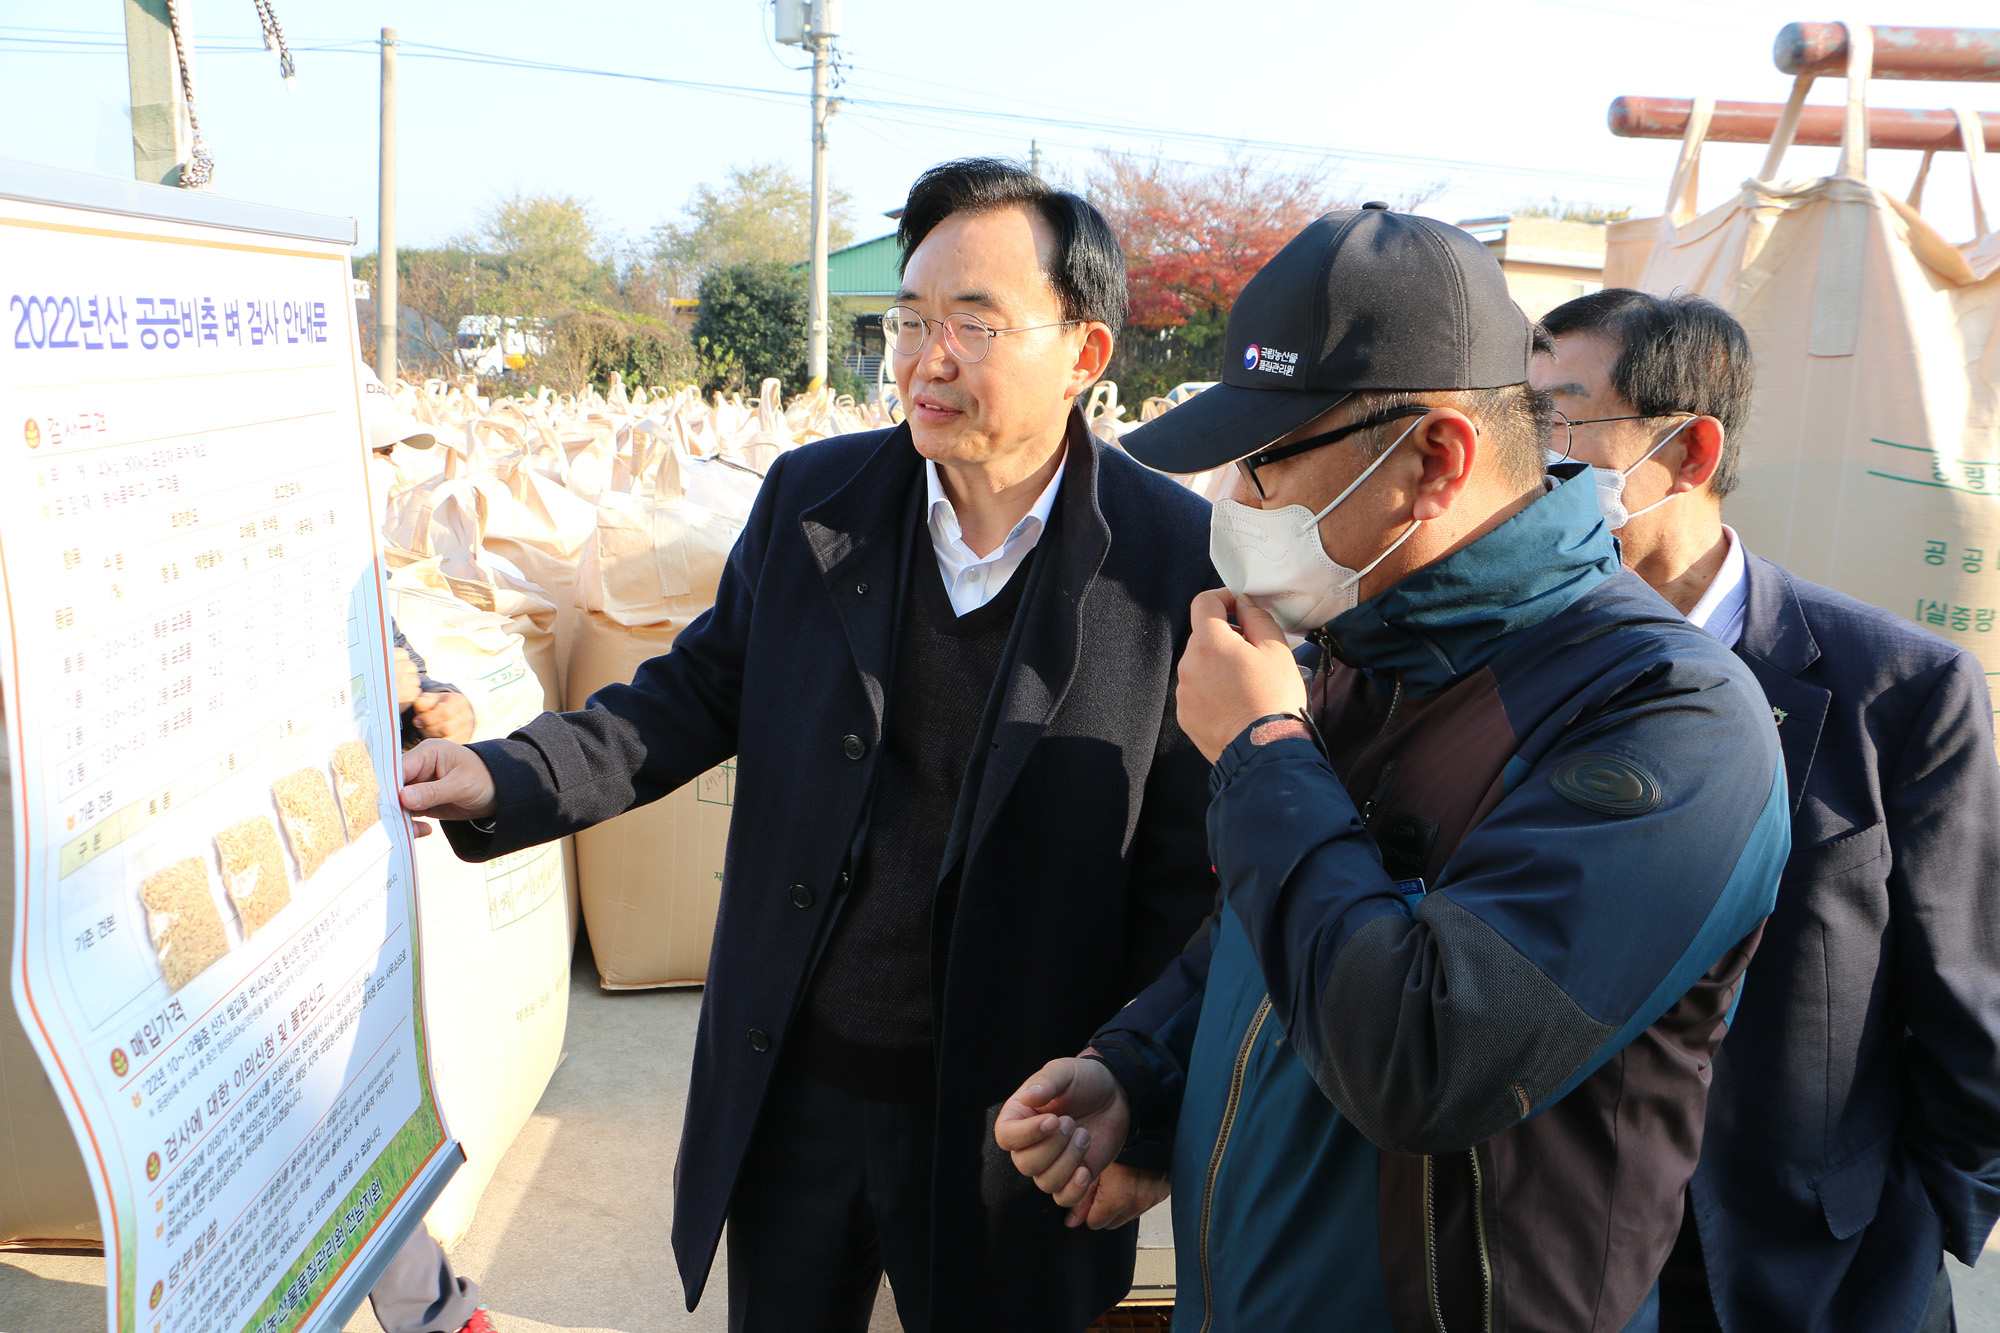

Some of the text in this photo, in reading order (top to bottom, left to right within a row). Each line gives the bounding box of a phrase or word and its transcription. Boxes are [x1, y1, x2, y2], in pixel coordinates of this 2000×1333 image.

[10, 295, 328, 351] 2022년산 공공비축 벼 검사 안내문
[1258, 359, 1295, 377] 품질관리원
[1261, 347, 1299, 364] 국립농산물
[47, 411, 108, 445] 검사규격
[74, 912, 117, 953] 기준 견본
[130, 998, 186, 1057] 매입가격
[165, 1107, 203, 1163] 검사에
[207, 1080, 230, 1116] 대한
[234, 1033, 274, 1088] 이의신청
[278, 1020, 287, 1045] 및
[291, 982, 325, 1032] 불편신고
[168, 1150, 204, 1202] 검사등급에
[208, 1125, 228, 1155] 이의가
[231, 1112, 243, 1133] 있어
[246, 1079, 270, 1113] 재검사를
[168, 1192, 189, 1226] 검사에
[281, 1191, 298, 1218] 마스크
[346, 1178, 382, 1233] 전남지원
[169, 1219, 217, 1289] 당부말씀
[244, 1255, 261, 1281] 주시기
[225, 1308, 237, 1331] 검사
